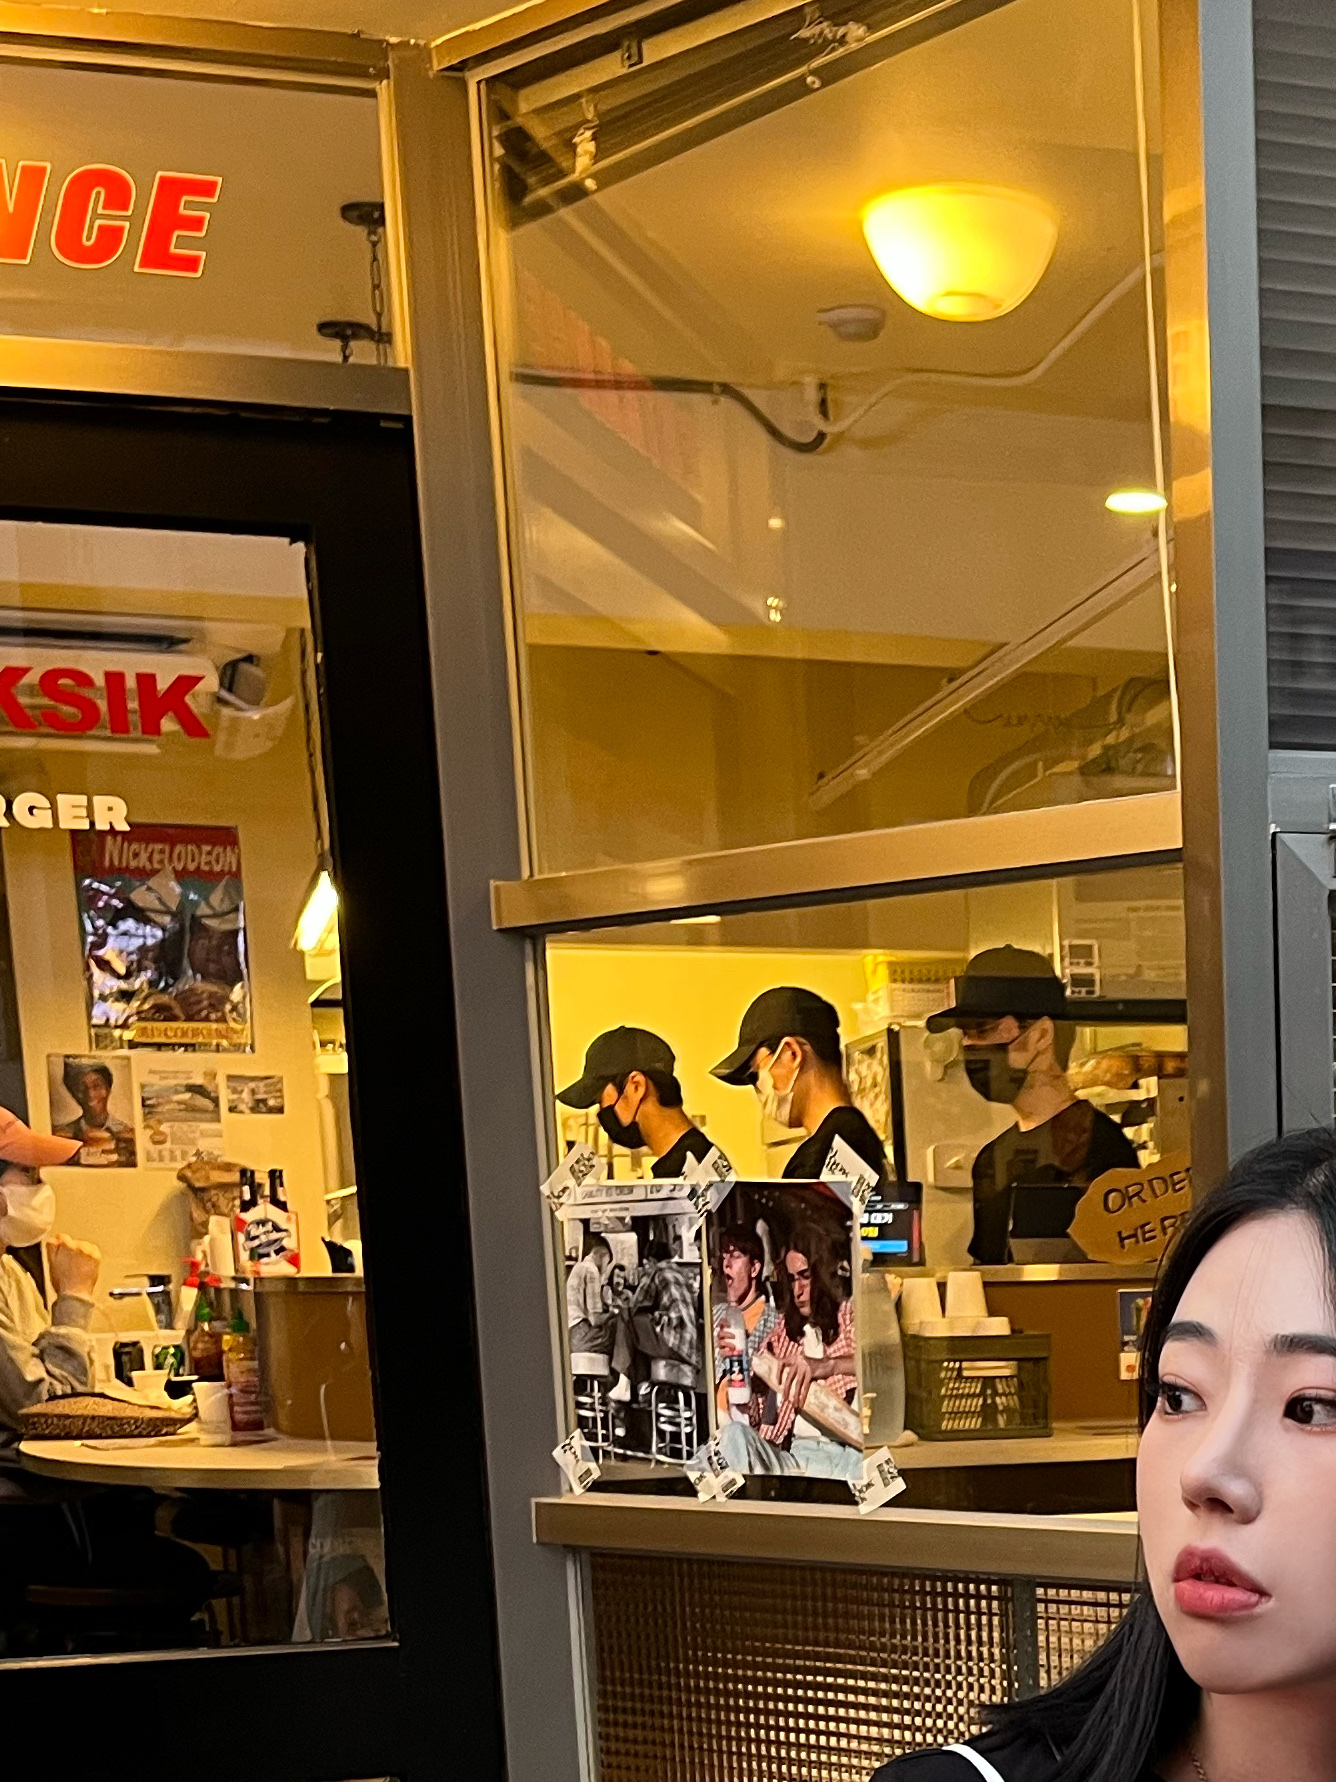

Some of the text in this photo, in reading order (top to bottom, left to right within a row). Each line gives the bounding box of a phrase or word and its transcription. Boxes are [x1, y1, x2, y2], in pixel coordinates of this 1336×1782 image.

[0, 791, 131, 832] GER
[1103, 1167, 1192, 1214] ORDE
[1117, 1211, 1189, 1249] HER
